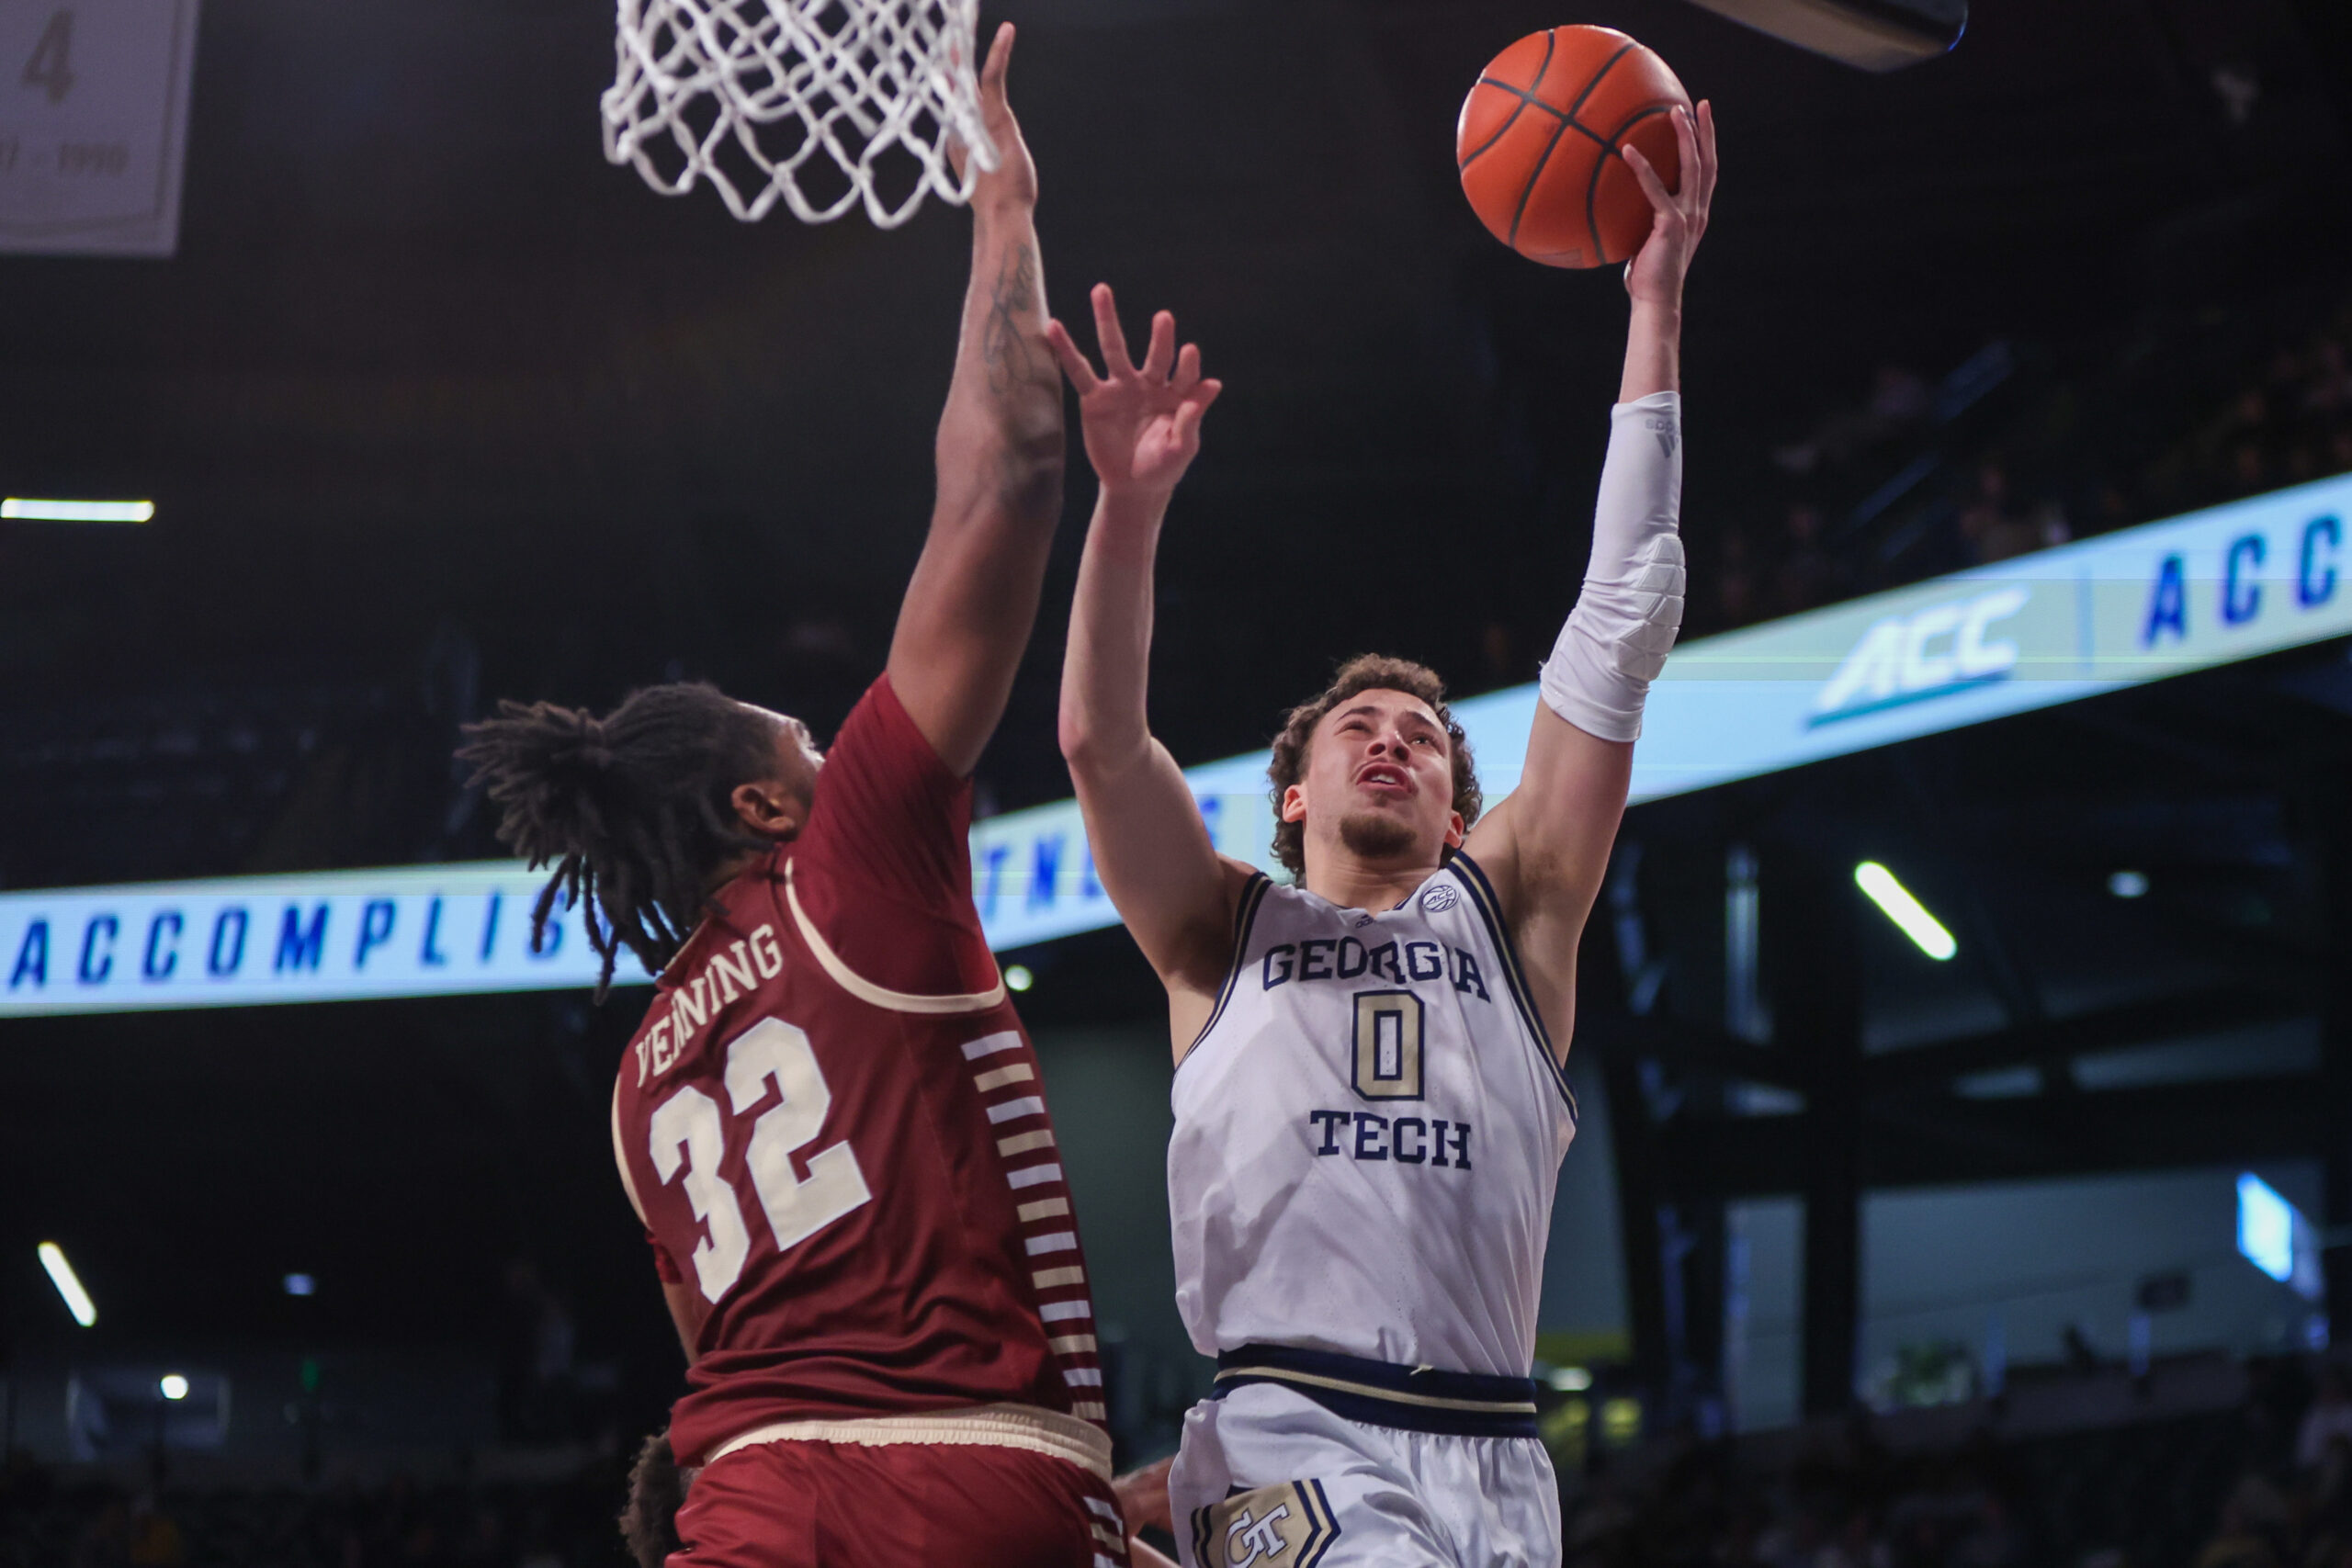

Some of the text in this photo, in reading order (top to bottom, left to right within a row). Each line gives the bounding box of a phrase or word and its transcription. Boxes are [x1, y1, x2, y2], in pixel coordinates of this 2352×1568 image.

[20, 9, 77, 107] 4
[1815, 584, 2030, 712] ACC
[8, 887, 625, 989] ACCOMPLIS
[1351, 989, 1425, 1101] 0
[649, 1016, 872, 1304] 32
[1310, 1110, 1472, 1170] TECH
